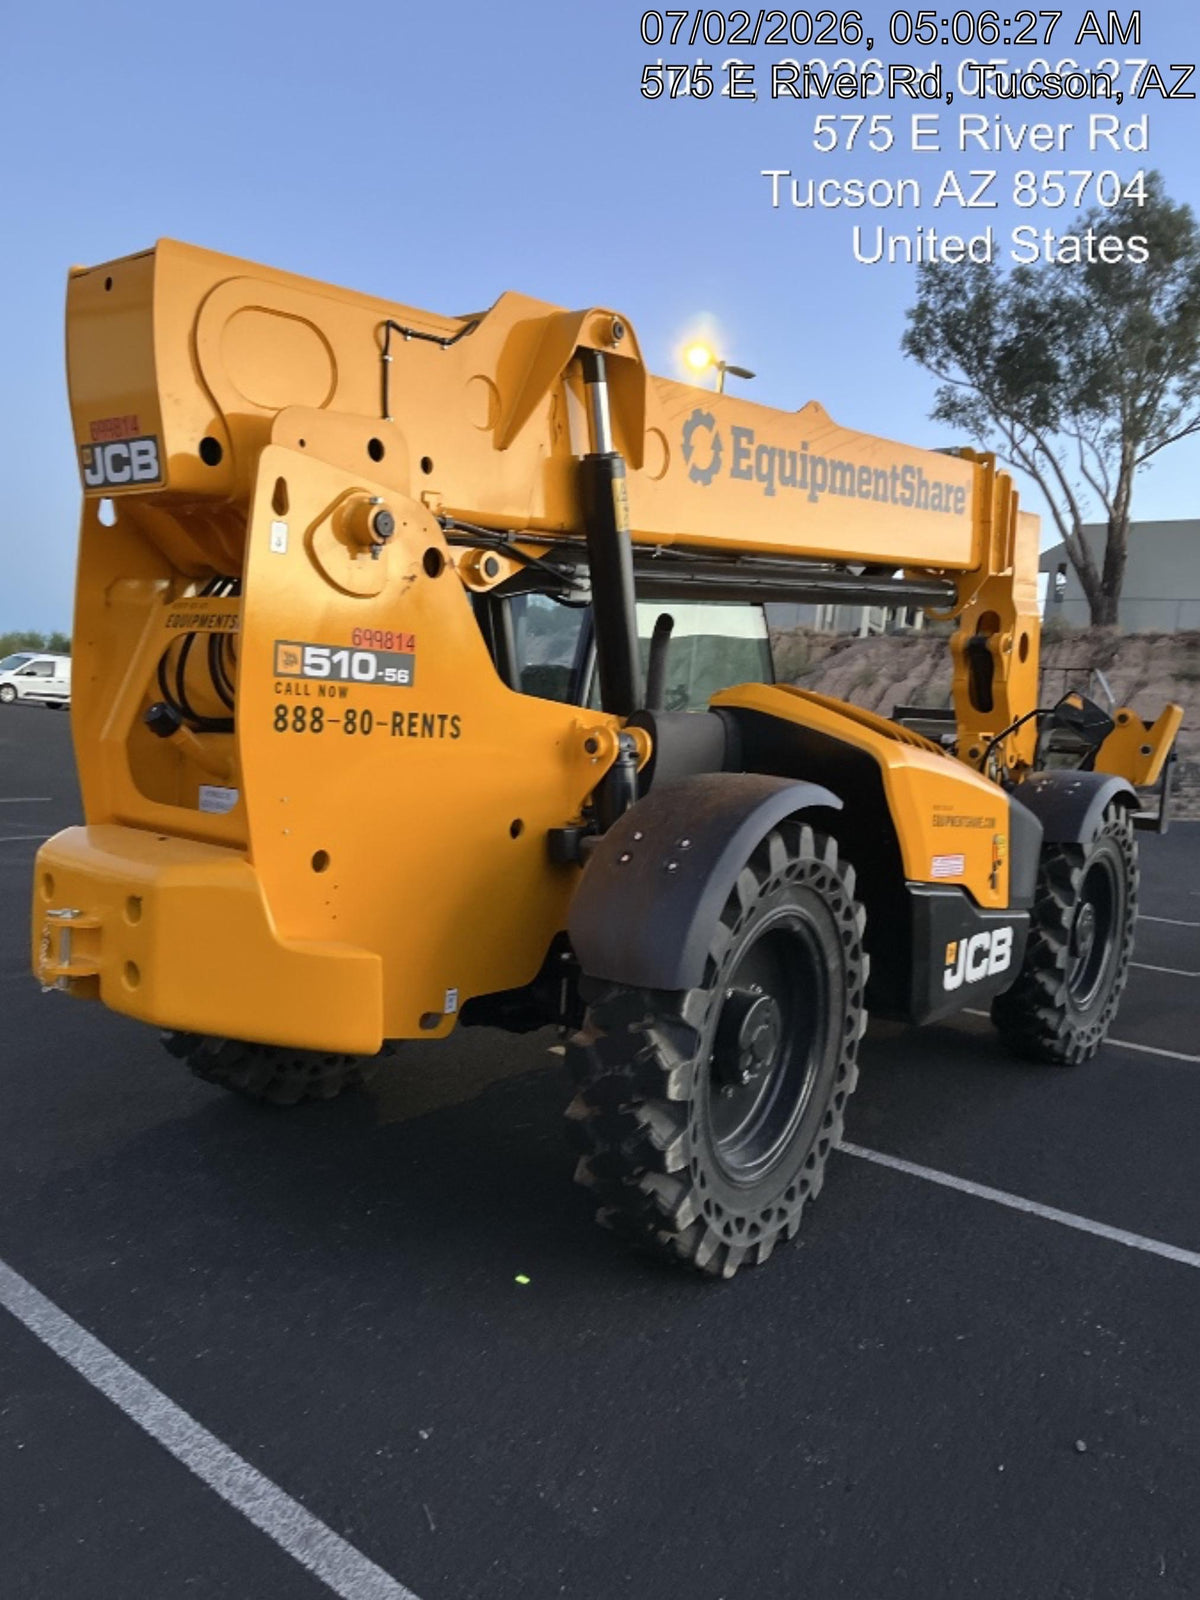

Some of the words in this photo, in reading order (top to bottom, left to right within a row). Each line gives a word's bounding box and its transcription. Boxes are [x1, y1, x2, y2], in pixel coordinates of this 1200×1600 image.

[84, 439, 160, 487] JCB
[730, 424, 967, 516] EquipmentShare
[352, 627, 416, 652] 699814
[274, 681, 311, 697] CALL
[317, 684, 349, 699] NOW
[273, 703, 463, 740] 888-80-RENTS
[943, 926, 1014, 991] JCB
